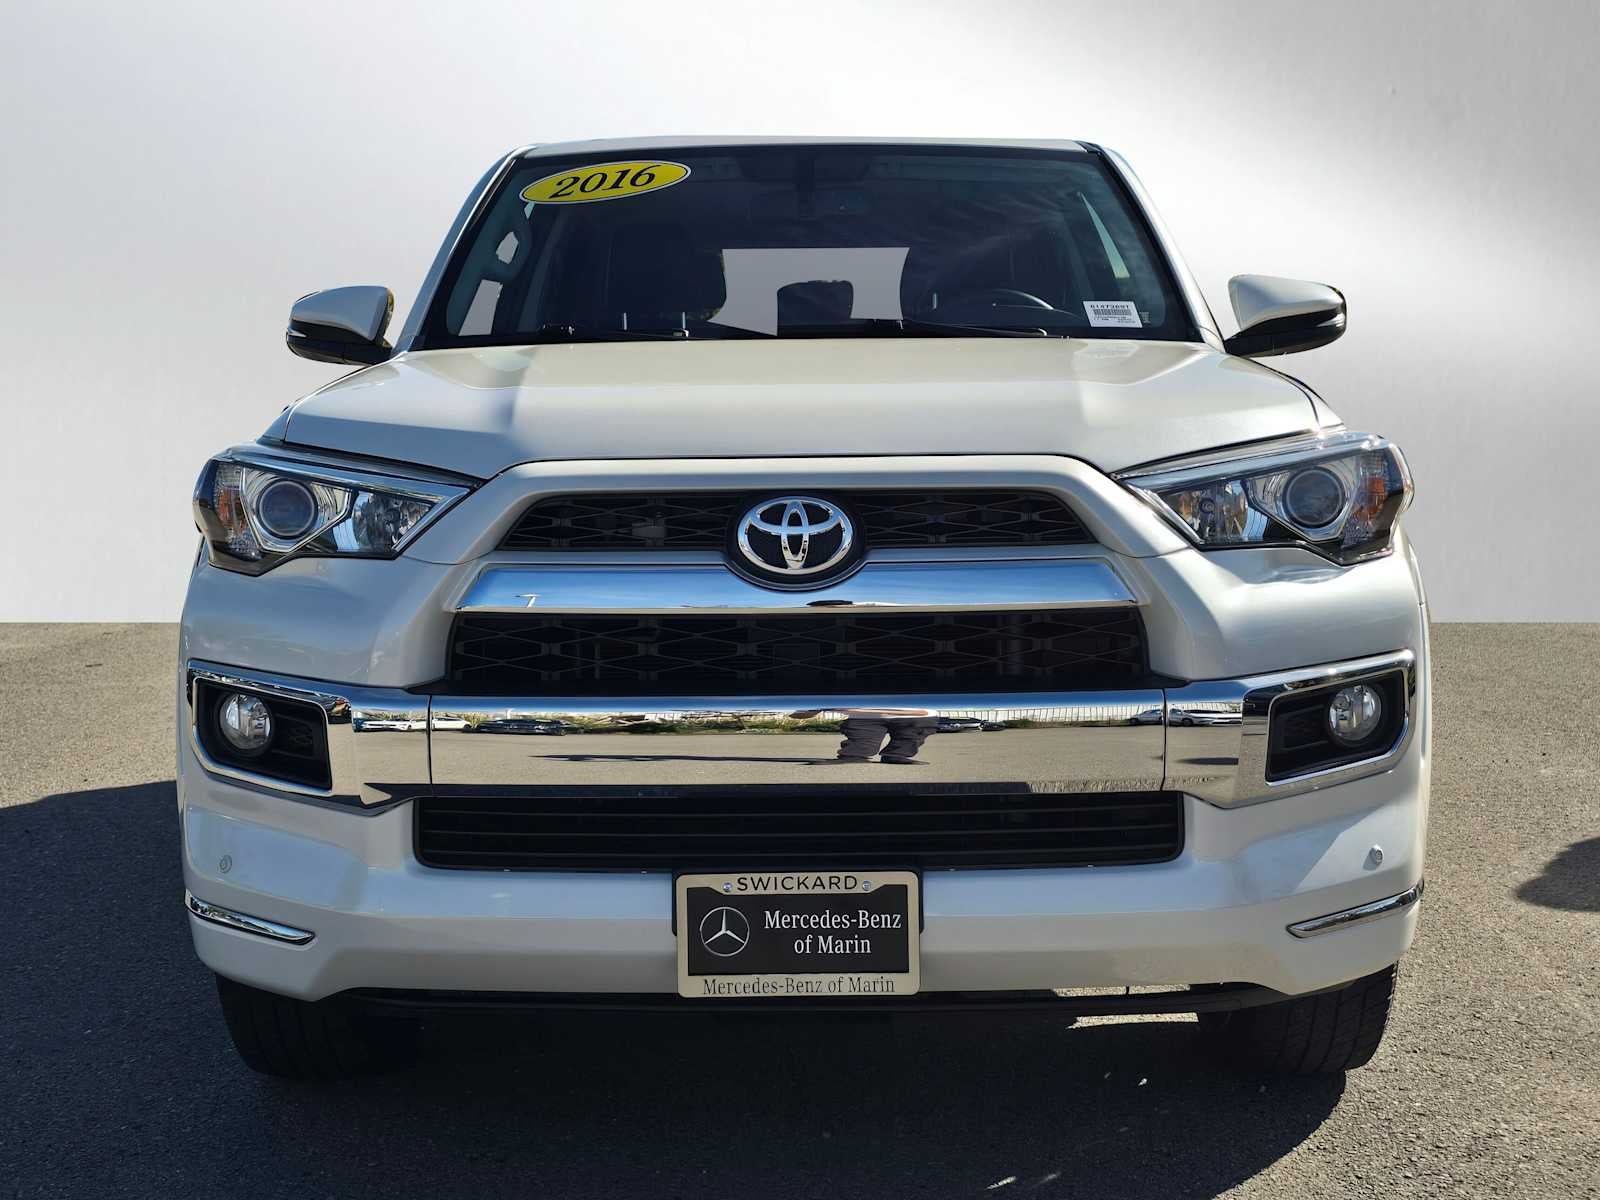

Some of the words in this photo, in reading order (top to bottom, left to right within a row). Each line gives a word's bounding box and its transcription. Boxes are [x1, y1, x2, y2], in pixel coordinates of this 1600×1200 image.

[548, 165, 661, 199] 2016
[737, 875, 858, 891] SWICKARD
[764, 910, 902, 929] Mercedes-Benz
[794, 934, 812, 954] of
[817, 935, 871, 954] Marin
[703, 977, 823, 995] Mercedes-Benz
[828, 976, 844, 993] of
[848, 976, 896, 993] Marin
